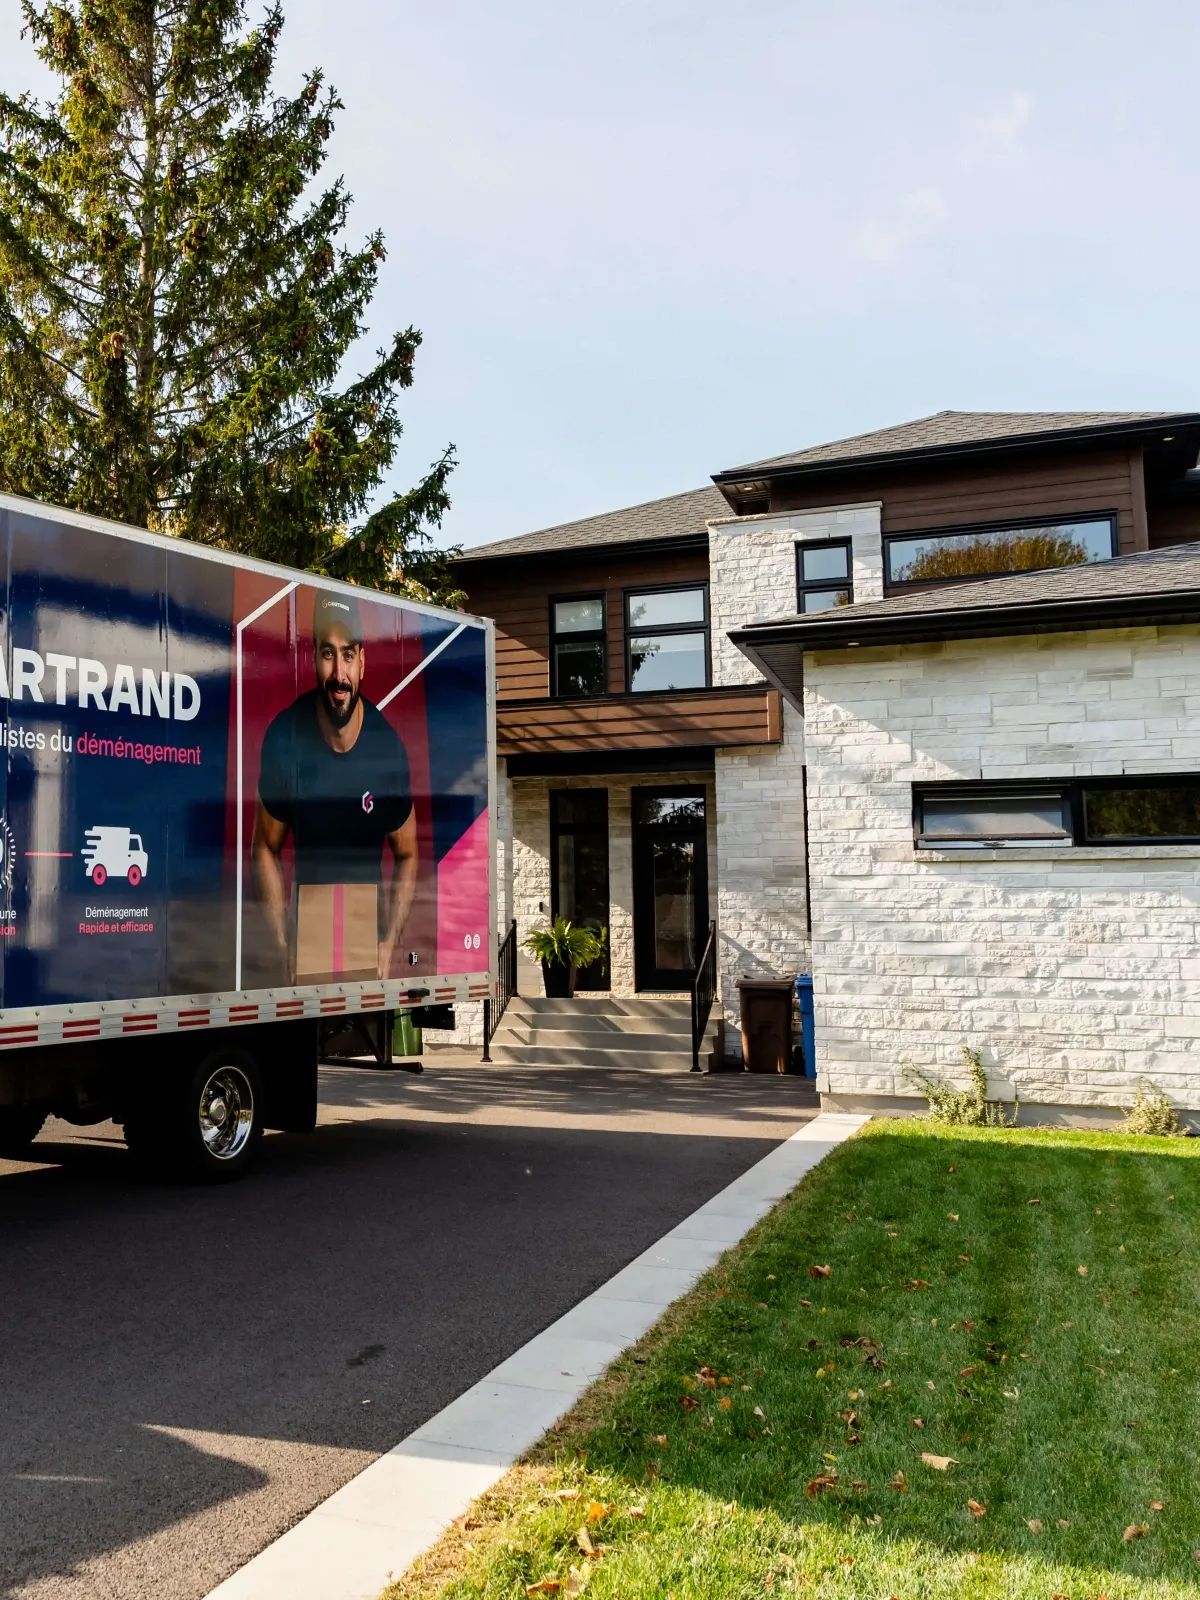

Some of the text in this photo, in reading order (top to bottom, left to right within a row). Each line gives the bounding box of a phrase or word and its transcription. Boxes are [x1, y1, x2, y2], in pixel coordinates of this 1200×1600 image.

[50, 729, 73, 753] du
[76, 732, 202, 765] déménagement
[0, 909, 17, 920] une
[85, 906, 149, 920] Déménagement
[79, 921, 154, 935] Rapide et efficace
